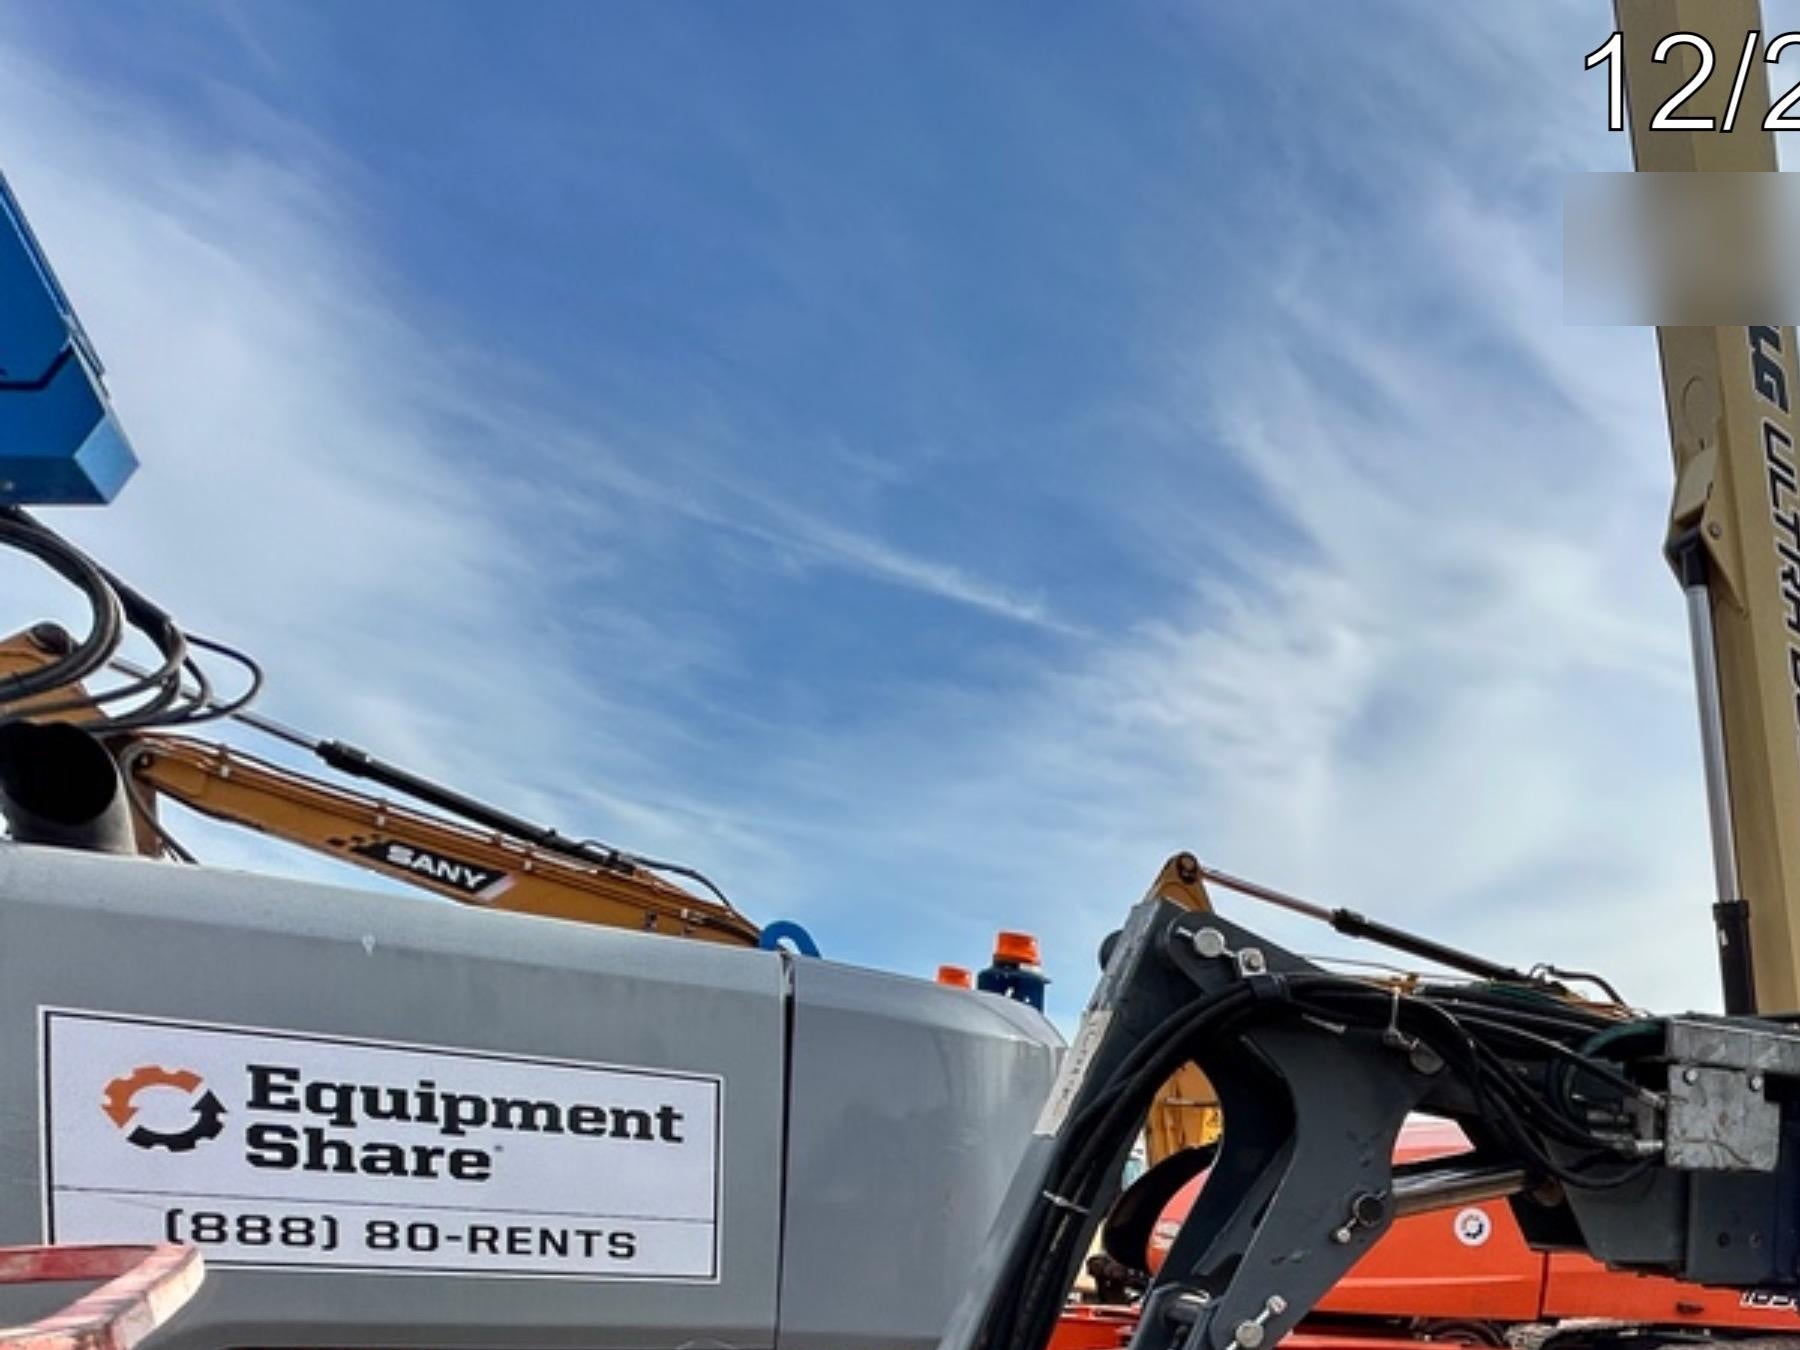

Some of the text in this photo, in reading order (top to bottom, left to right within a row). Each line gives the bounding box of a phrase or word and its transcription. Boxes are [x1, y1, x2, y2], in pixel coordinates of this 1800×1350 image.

[386, 844, 488, 889] SANY
[245, 1063, 684, 1142] Equipment
[245, 1123, 492, 1182] Share
[165, 1208, 638, 1260] (888) 80-RENTS
